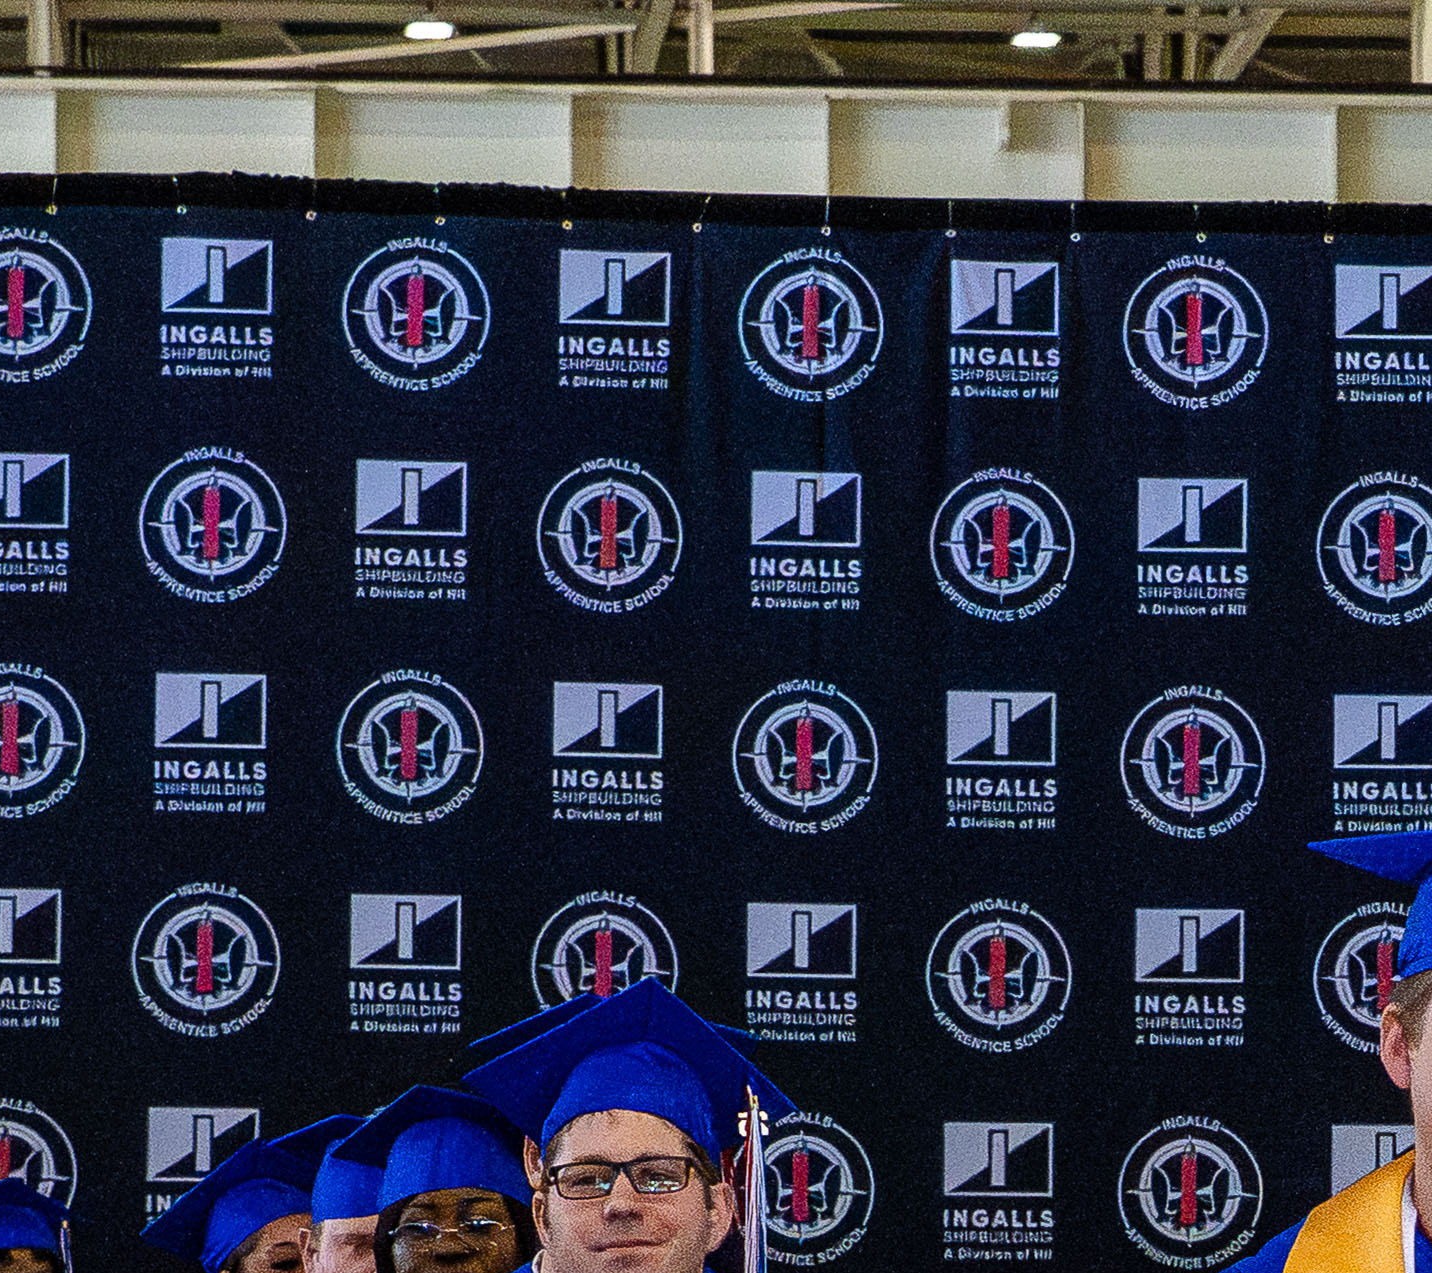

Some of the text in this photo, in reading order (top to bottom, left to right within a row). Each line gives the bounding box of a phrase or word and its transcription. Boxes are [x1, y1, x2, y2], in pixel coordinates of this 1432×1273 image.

[387, 236, 448, 254] INGALLS
[783, 247, 843, 265] INGALLS
[160, 323, 273, 346] INGALLS
[160, 346, 272, 361] SHIPBUILDING
[558, 335, 671, 358] INGALLS
[949, 345, 1060, 368] INGALLS
[349, 349, 483, 392] APPRENTICE SCHOOL
[949, 368, 1059, 383] SHIPBUILDING
[745, 360, 876, 403] APPRENTICE SCHOOL
[949, 385, 961, 397] A
[963, 385, 1019, 398] Division
[1023, 385, 1037, 398] of
[581, 457, 642, 475] INGALLS
[973, 467, 1033, 485] INGALLS
[1360, 471, 1420, 489] INGALLS
[354, 545, 467, 568] INGALLS
[354, 568, 466, 583] SHIPBUILDING
[750, 556, 861, 579] INGALLS
[1137, 562, 1248, 585] INGALLS
[354, 585, 366, 599] A
[368, 585, 425, 599] Division
[429, 586, 443, 599] of
[543, 571, 675, 614] APPRENTICE SCHOOL
[750, 579, 860, 594] SHIPBUILDING
[1137, 585, 1247, 600] SHIPBUILDING
[936, 580, 1068, 623] APPRENTICE SCHOOL
[1137, 603, 1149, 616] A
[1151, 602, 1206, 616] Division
[1210, 603, 1224, 615] of
[1323, 584, 1402, 627] APPRENTICE
[776, 679, 837, 697] INGALLS
[1164, 684, 1224, 702] INGALLS
[153, 758, 267, 781] INGALLS
[551, 768, 663, 791] INGALLS
[946, 776, 1057, 798] INGALLS
[23, 779, 78, 816] SCHOOL
[551, 791, 662, 806] SHIPBUILDING
[946, 798, 1056, 813] SHIPBUILDING
[739, 792, 871, 835] APPRENTICE SCHOOL
[946, 816, 958, 829] A
[960, 816, 1015, 829] Division
[1019, 816, 1033, 829] of
[1127, 798, 1259, 841] APPRENTICE SCHOOL
[177, 881, 239, 900] INGALLS
[970, 898, 1030, 916] INGALLS
[348, 979, 462, 1002] INGALLS
[746, 988, 857, 1011] INGALLS
[348, 1002, 461, 1017] SHIPBUILDING
[1134, 993, 1245, 1016] INGALLS
[23, 1014, 37, 1027] of
[138, 995, 273, 1039] APPRENTICE SCHOOL
[746, 1011, 856, 1026] SHIPBUILDING
[1134, 1016, 1244, 1030] SHIPBUILDING
[933, 1011, 1065, 1054] APPRENTICE SCHOOL
[1161, 1115, 1221, 1133] INGALLS
[942, 1207, 1054, 1229] INGALLS
[1124, 1228, 1256, 1271] APPRENTICE SCHOOL
